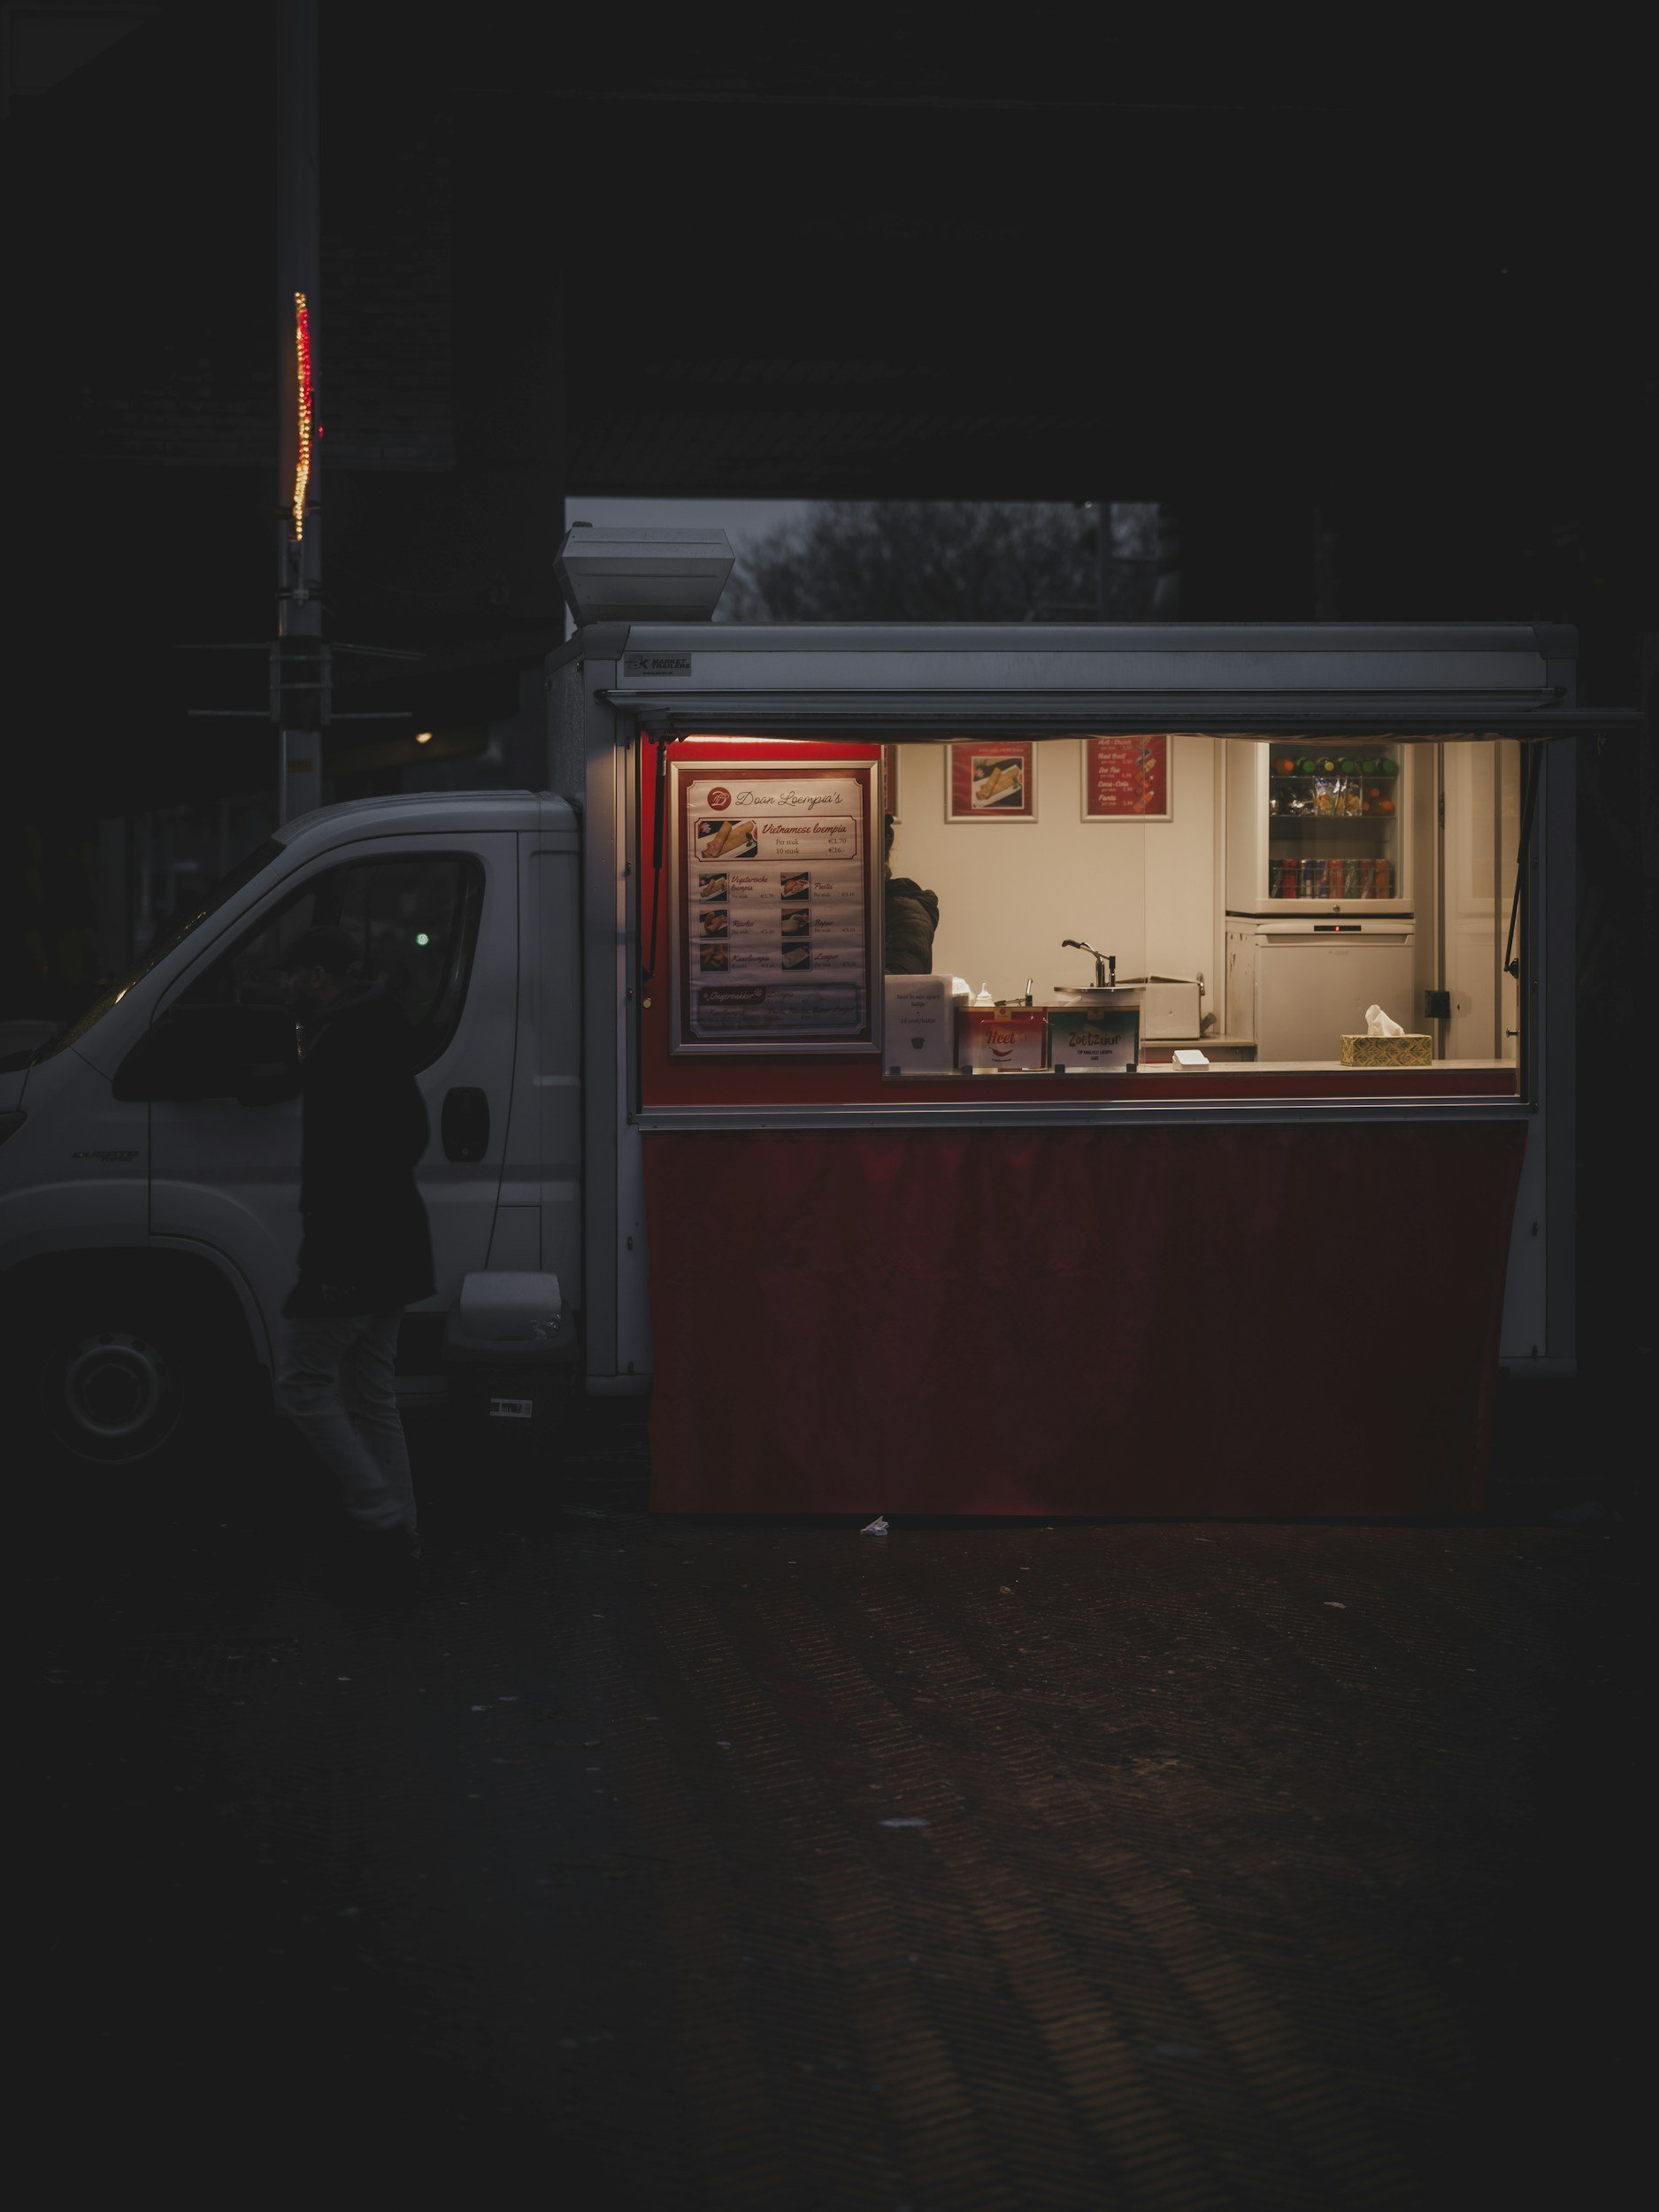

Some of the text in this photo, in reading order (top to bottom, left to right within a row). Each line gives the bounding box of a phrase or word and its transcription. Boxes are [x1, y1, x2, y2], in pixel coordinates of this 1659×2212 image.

[735, 790, 843, 810] Doan Loempia's
[763, 823, 848, 836] Vietnamese loempia
[985, 1031, 1015, 1044] Heet
